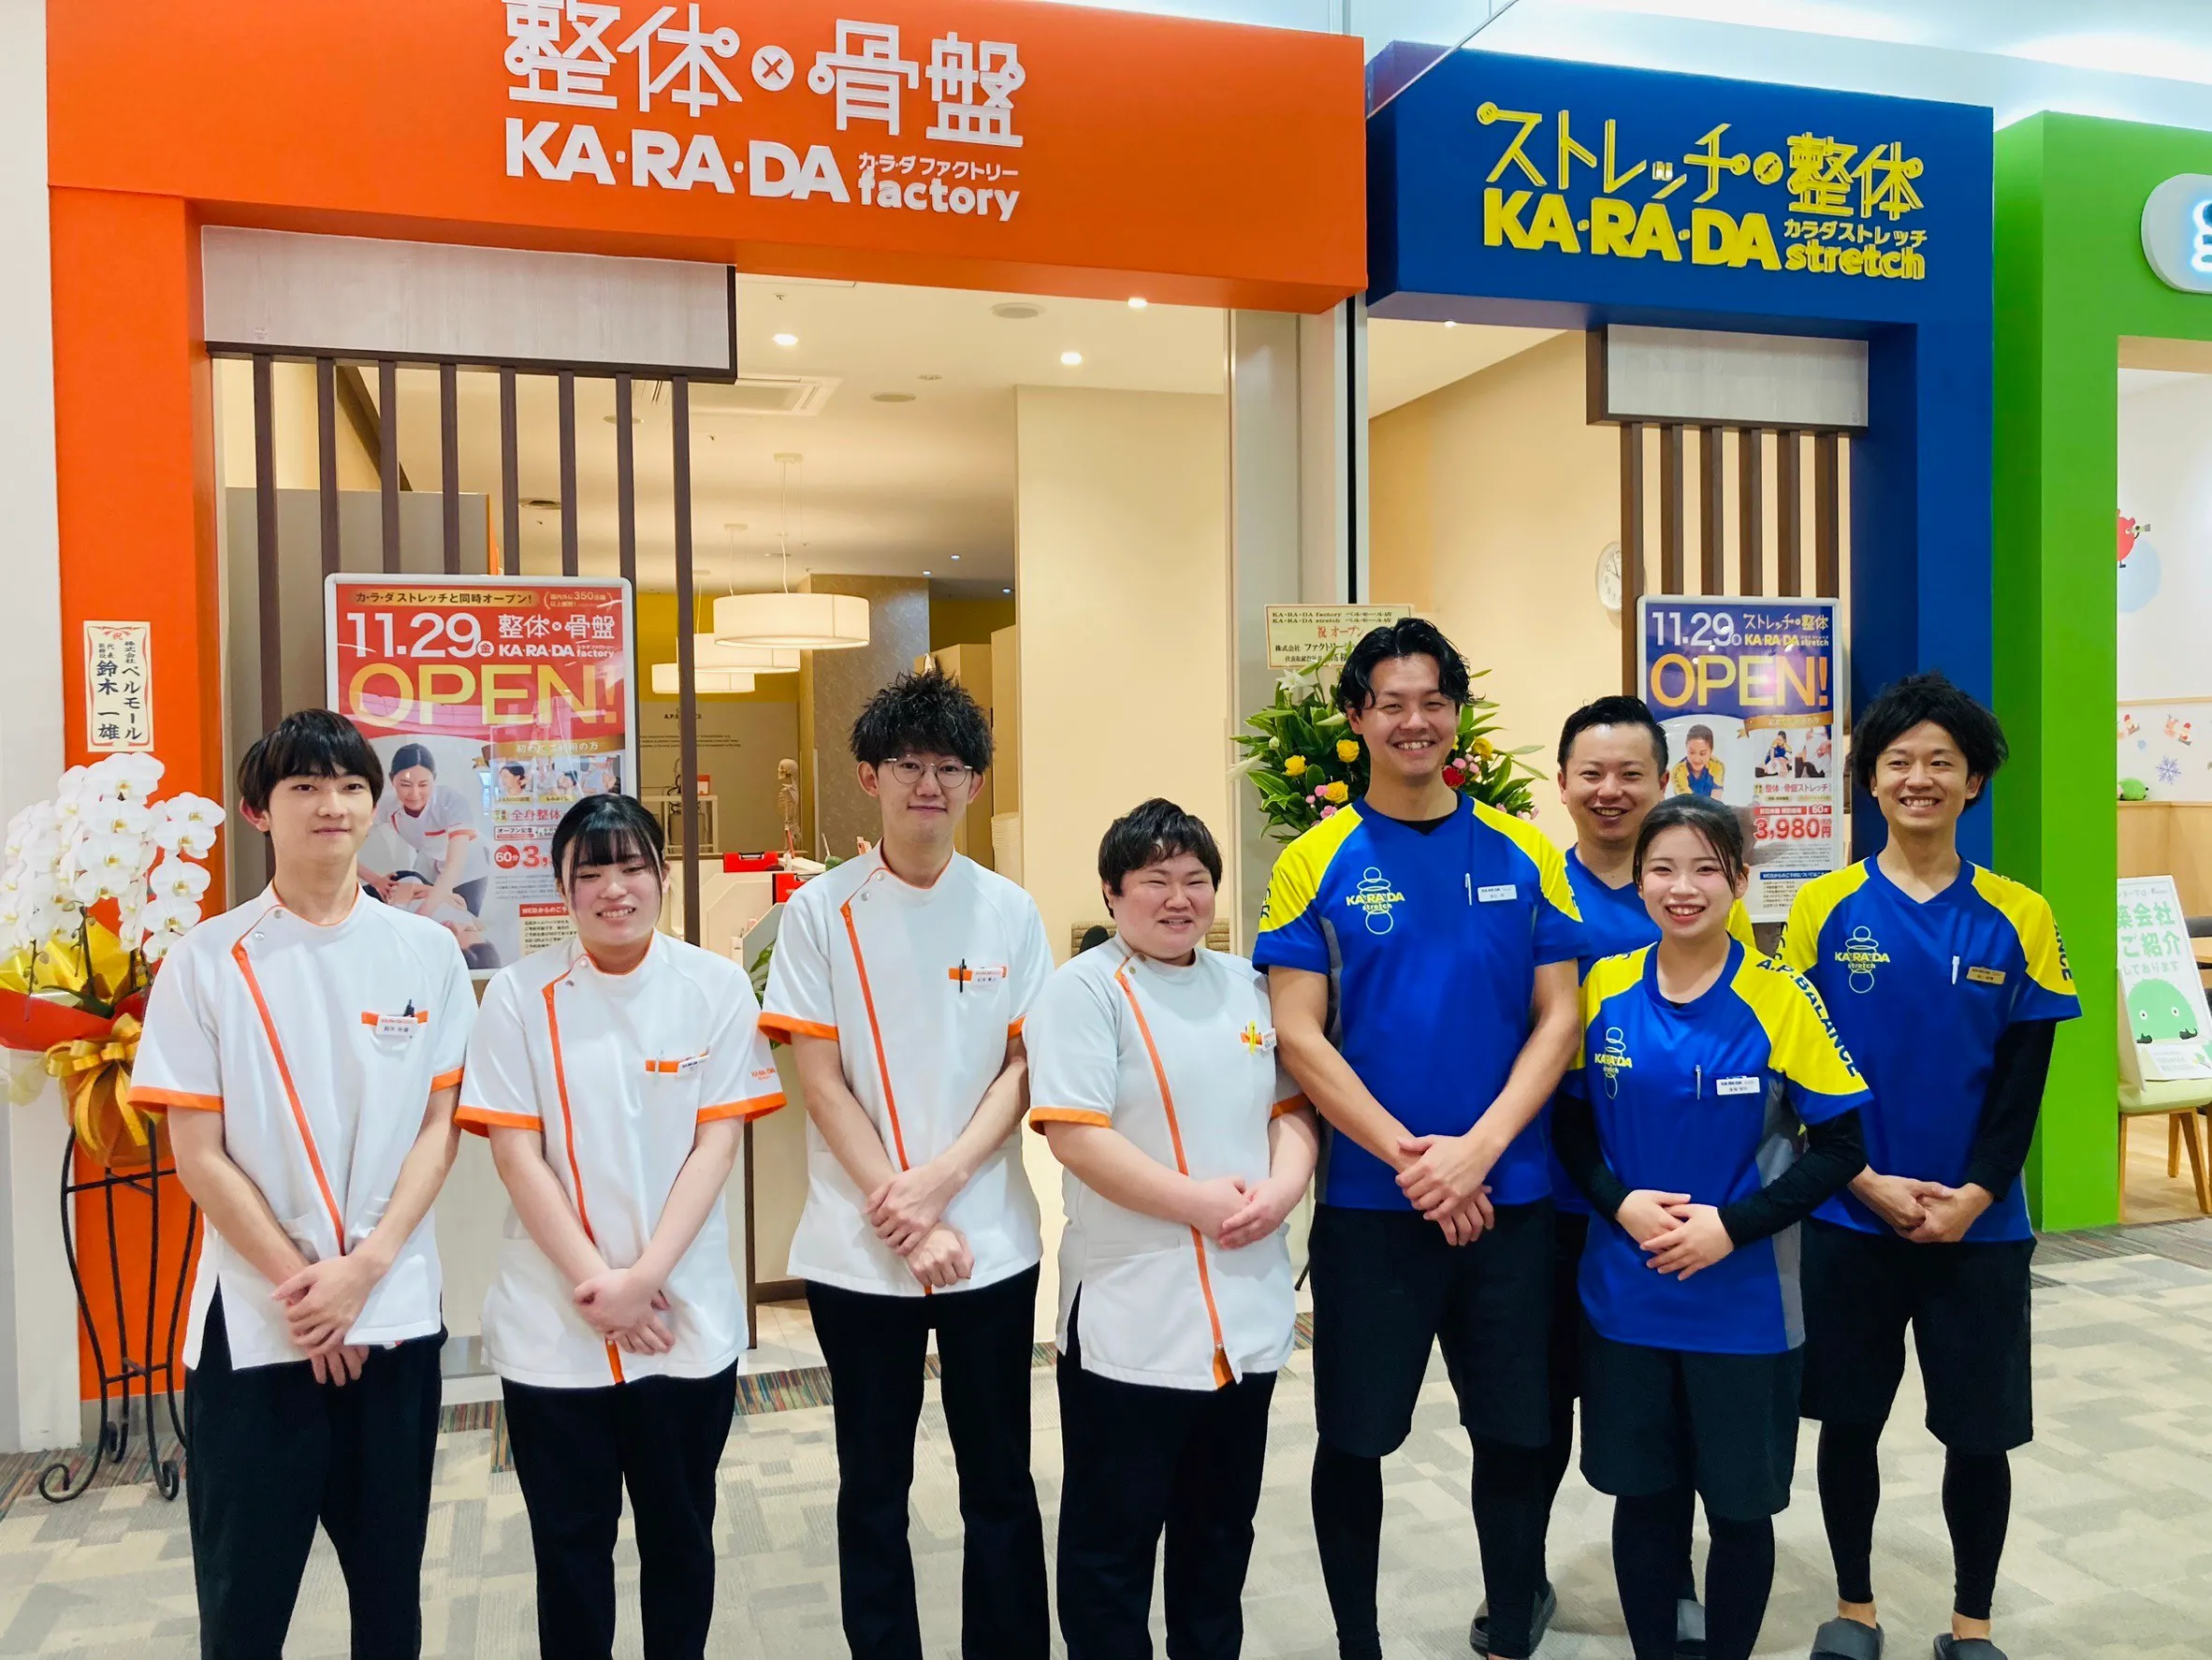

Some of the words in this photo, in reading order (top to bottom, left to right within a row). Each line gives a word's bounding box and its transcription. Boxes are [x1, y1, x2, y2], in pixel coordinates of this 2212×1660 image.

[858, 167, 1020, 222] factory
[1784, 239, 1926, 280] stretch
[347, 613, 482, 658] 11.29
[576, 649, 615, 658] factory
[1652, 612, 1734, 647] 11.29
[122, 665, 142, 740] ベルモール
[349, 663, 618, 727] OPEN!
[1651, 653, 1828, 707] OPEN!
